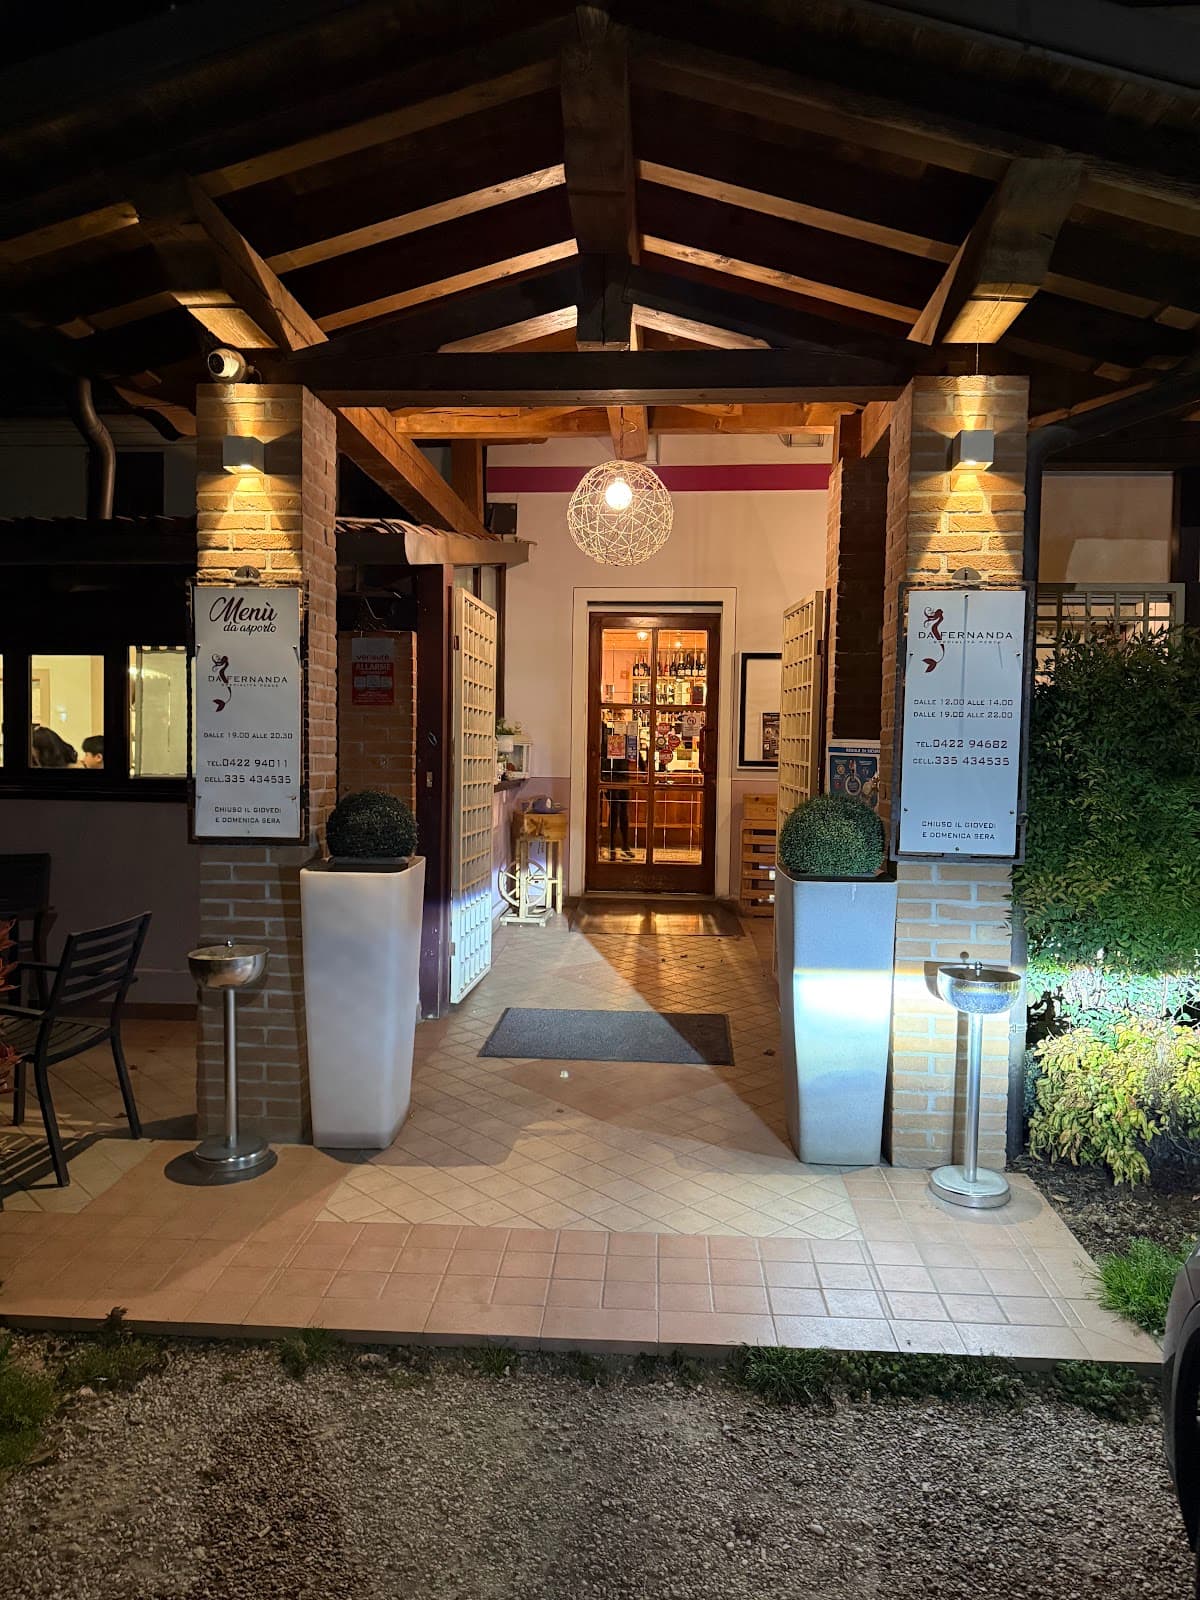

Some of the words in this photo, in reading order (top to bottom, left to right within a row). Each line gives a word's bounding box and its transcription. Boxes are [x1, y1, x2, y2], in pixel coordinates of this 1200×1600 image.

[209, 596, 278, 624] Menù
[223, 621, 238, 632] da
[239, 621, 277, 636] asporto
[918, 631, 934, 639] DA
[940, 631, 1013, 639] FERNANDA
[207, 675, 222, 683] DA
[227, 675, 288, 683] FERNANDA
[940, 698, 965, 706] 12.00
[987, 711, 1013, 719] 22.00
[968, 739, 1008, 749] 94682
[254, 759, 287, 768] 94011
[962, 756, 1010, 766] 434535
[249, 775, 292, 784] 434535
[929, 831, 972, 839] DOMENICA
